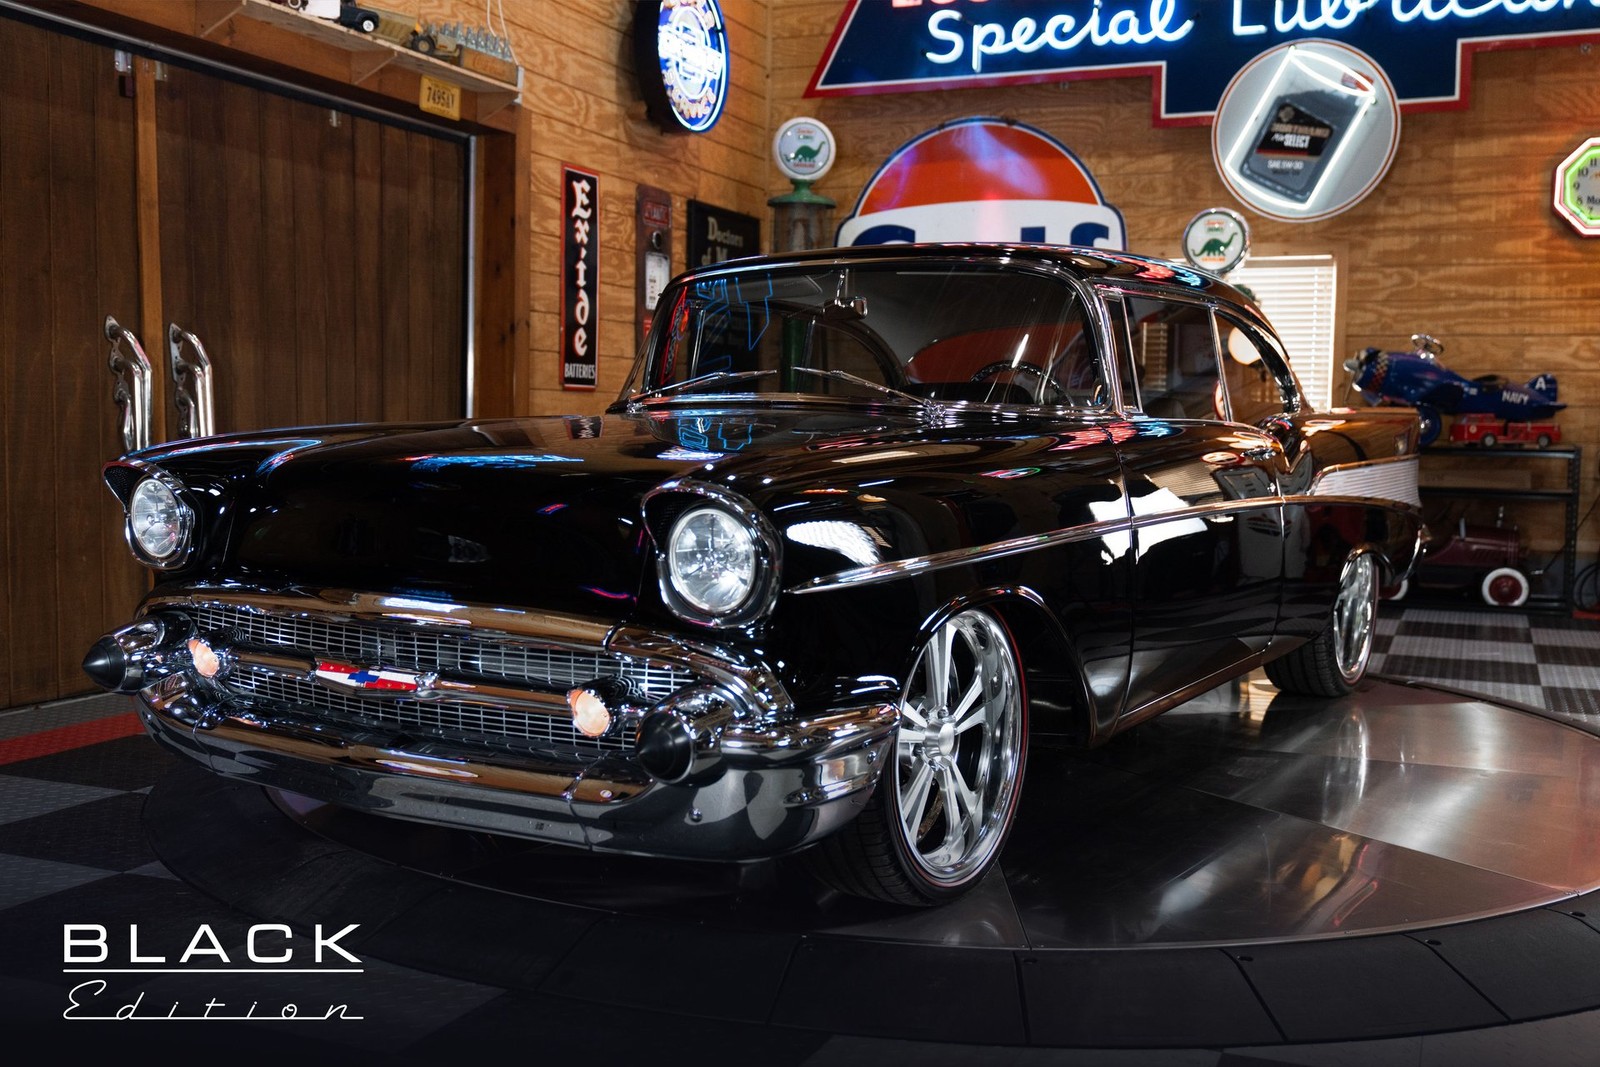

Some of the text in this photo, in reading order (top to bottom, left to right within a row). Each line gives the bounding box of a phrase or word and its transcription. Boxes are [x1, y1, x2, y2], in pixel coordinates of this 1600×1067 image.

[926, 0, 1195, 72] Special
[571, 179, 592, 356] Exide
[564, 363, 596, 380] BATTERIES
[1535, 376, 1547, 391] A
[1501, 389, 1529, 406] NAVY
